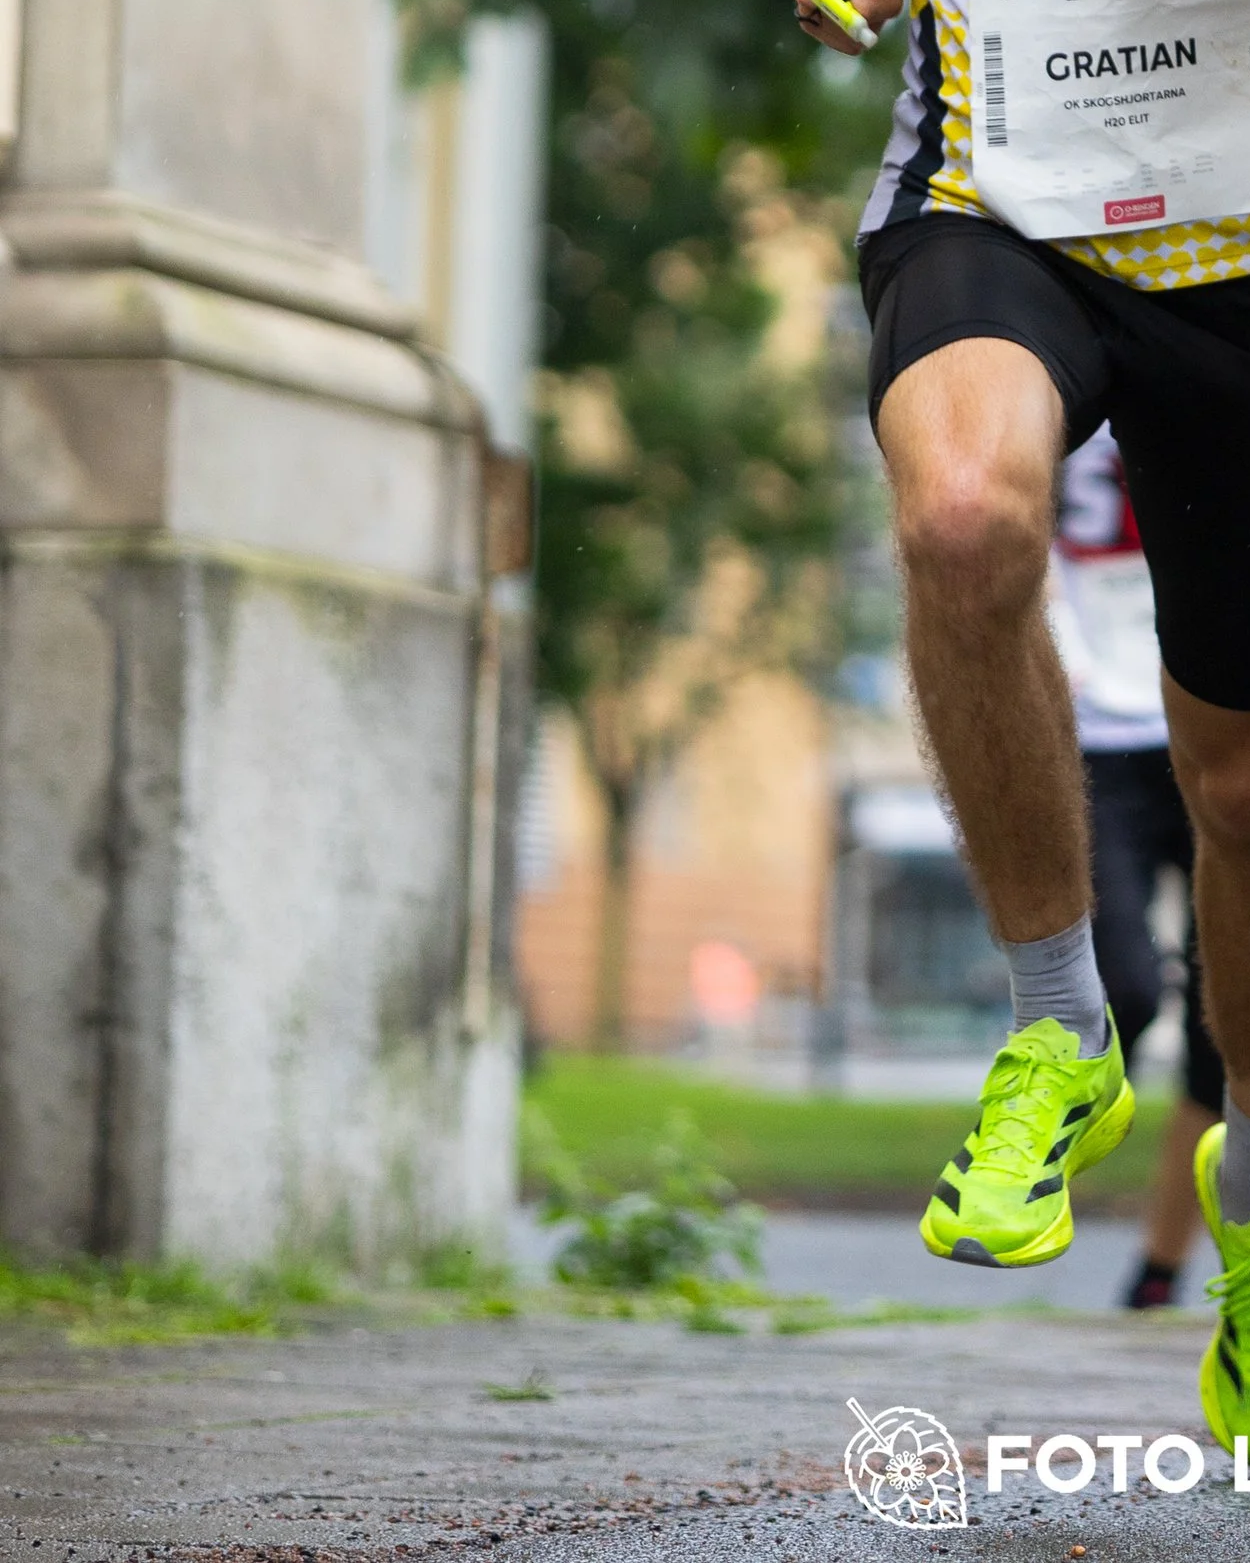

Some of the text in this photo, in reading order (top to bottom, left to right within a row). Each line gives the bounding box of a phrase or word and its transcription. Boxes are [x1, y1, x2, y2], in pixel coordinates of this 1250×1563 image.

[1045, 37, 1198, 81] GRATIAN
[1063, 87, 1186, 110] OK SKOGSHJORTARNA
[1128, 113, 1150, 125] ELIT
